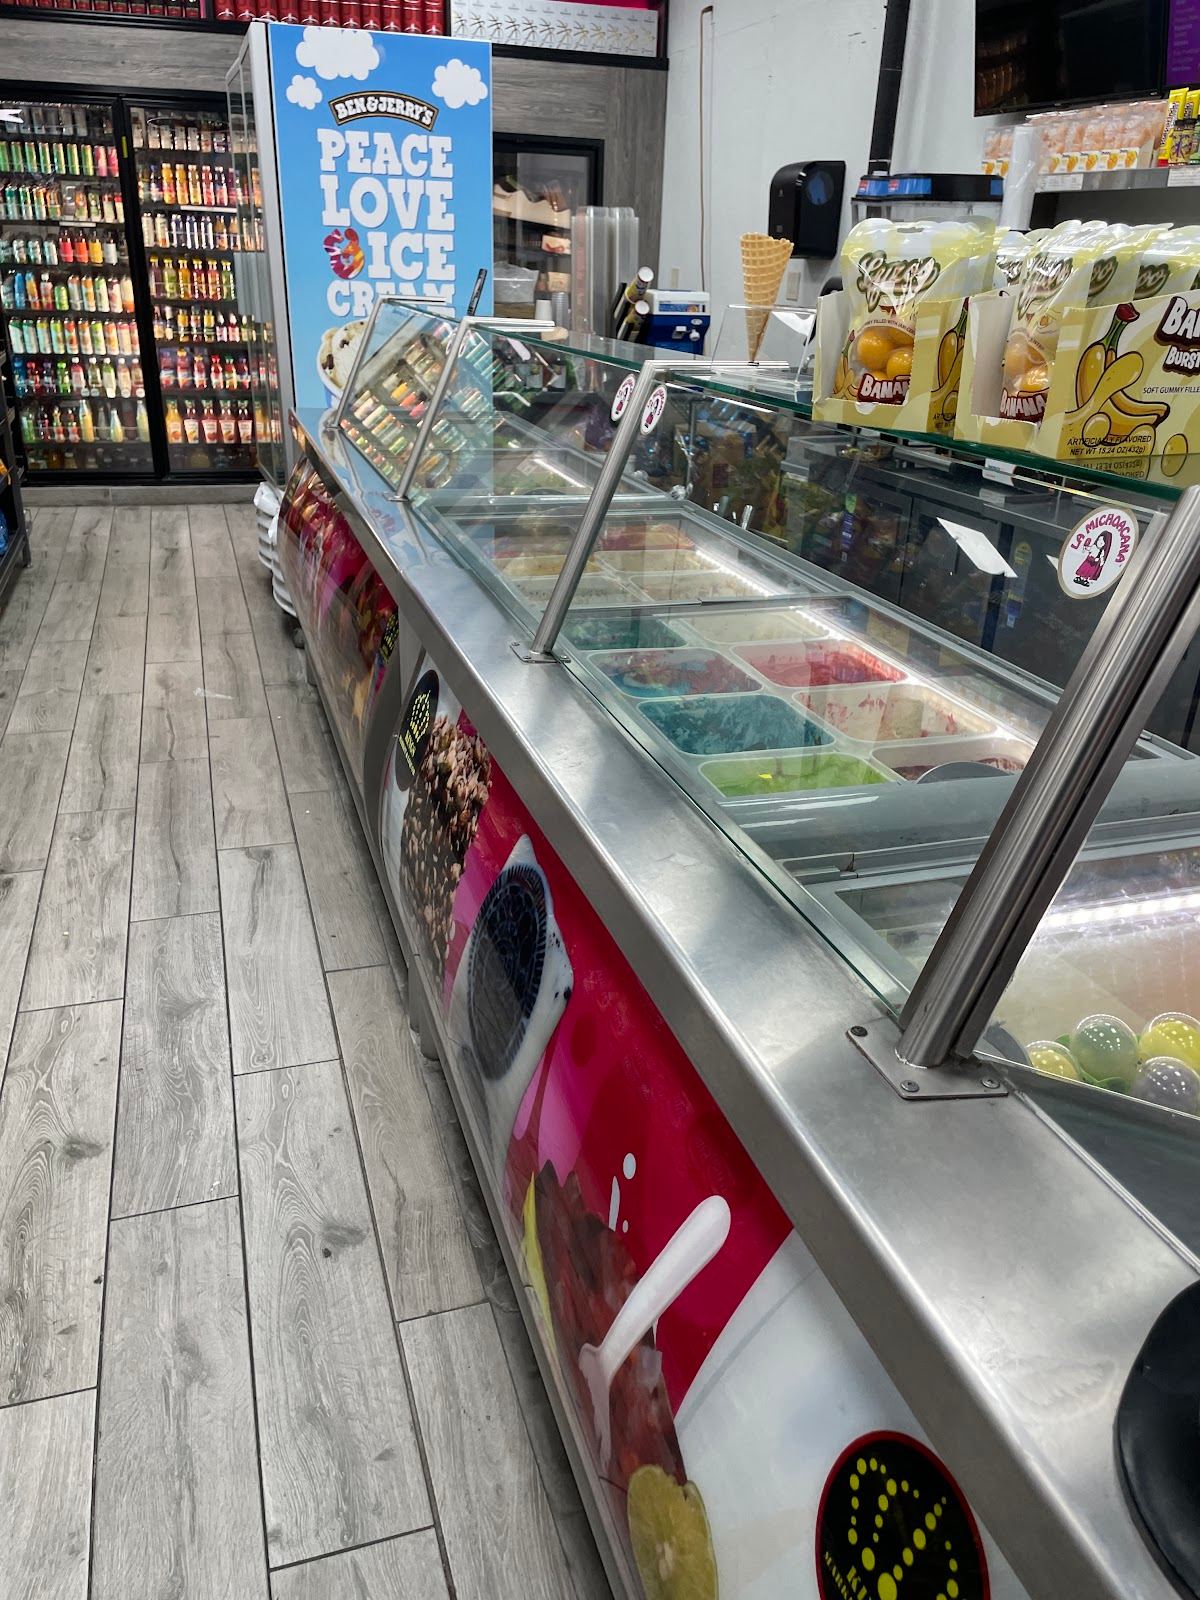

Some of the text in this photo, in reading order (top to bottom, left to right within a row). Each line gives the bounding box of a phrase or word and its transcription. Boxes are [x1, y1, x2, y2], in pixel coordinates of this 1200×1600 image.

[336, 96, 434, 125] BEN&JERRY'S
[317, 128, 454, 178] PEACE
[320, 174, 456, 232] LOVE
[366, 231, 456, 281] ICE
[1000, 390, 1046, 417] BANANA
[1143, 386, 1159, 394] SOFT
[1159, 386, 1184, 394] GUMMY
[1069, 448, 1084, 456] NET
[1098, 447, 1115, 455] 15.24
[1117, 435, 1152, 443] FLAVORED
[1085, 513, 1132, 563] MICHOACANA
